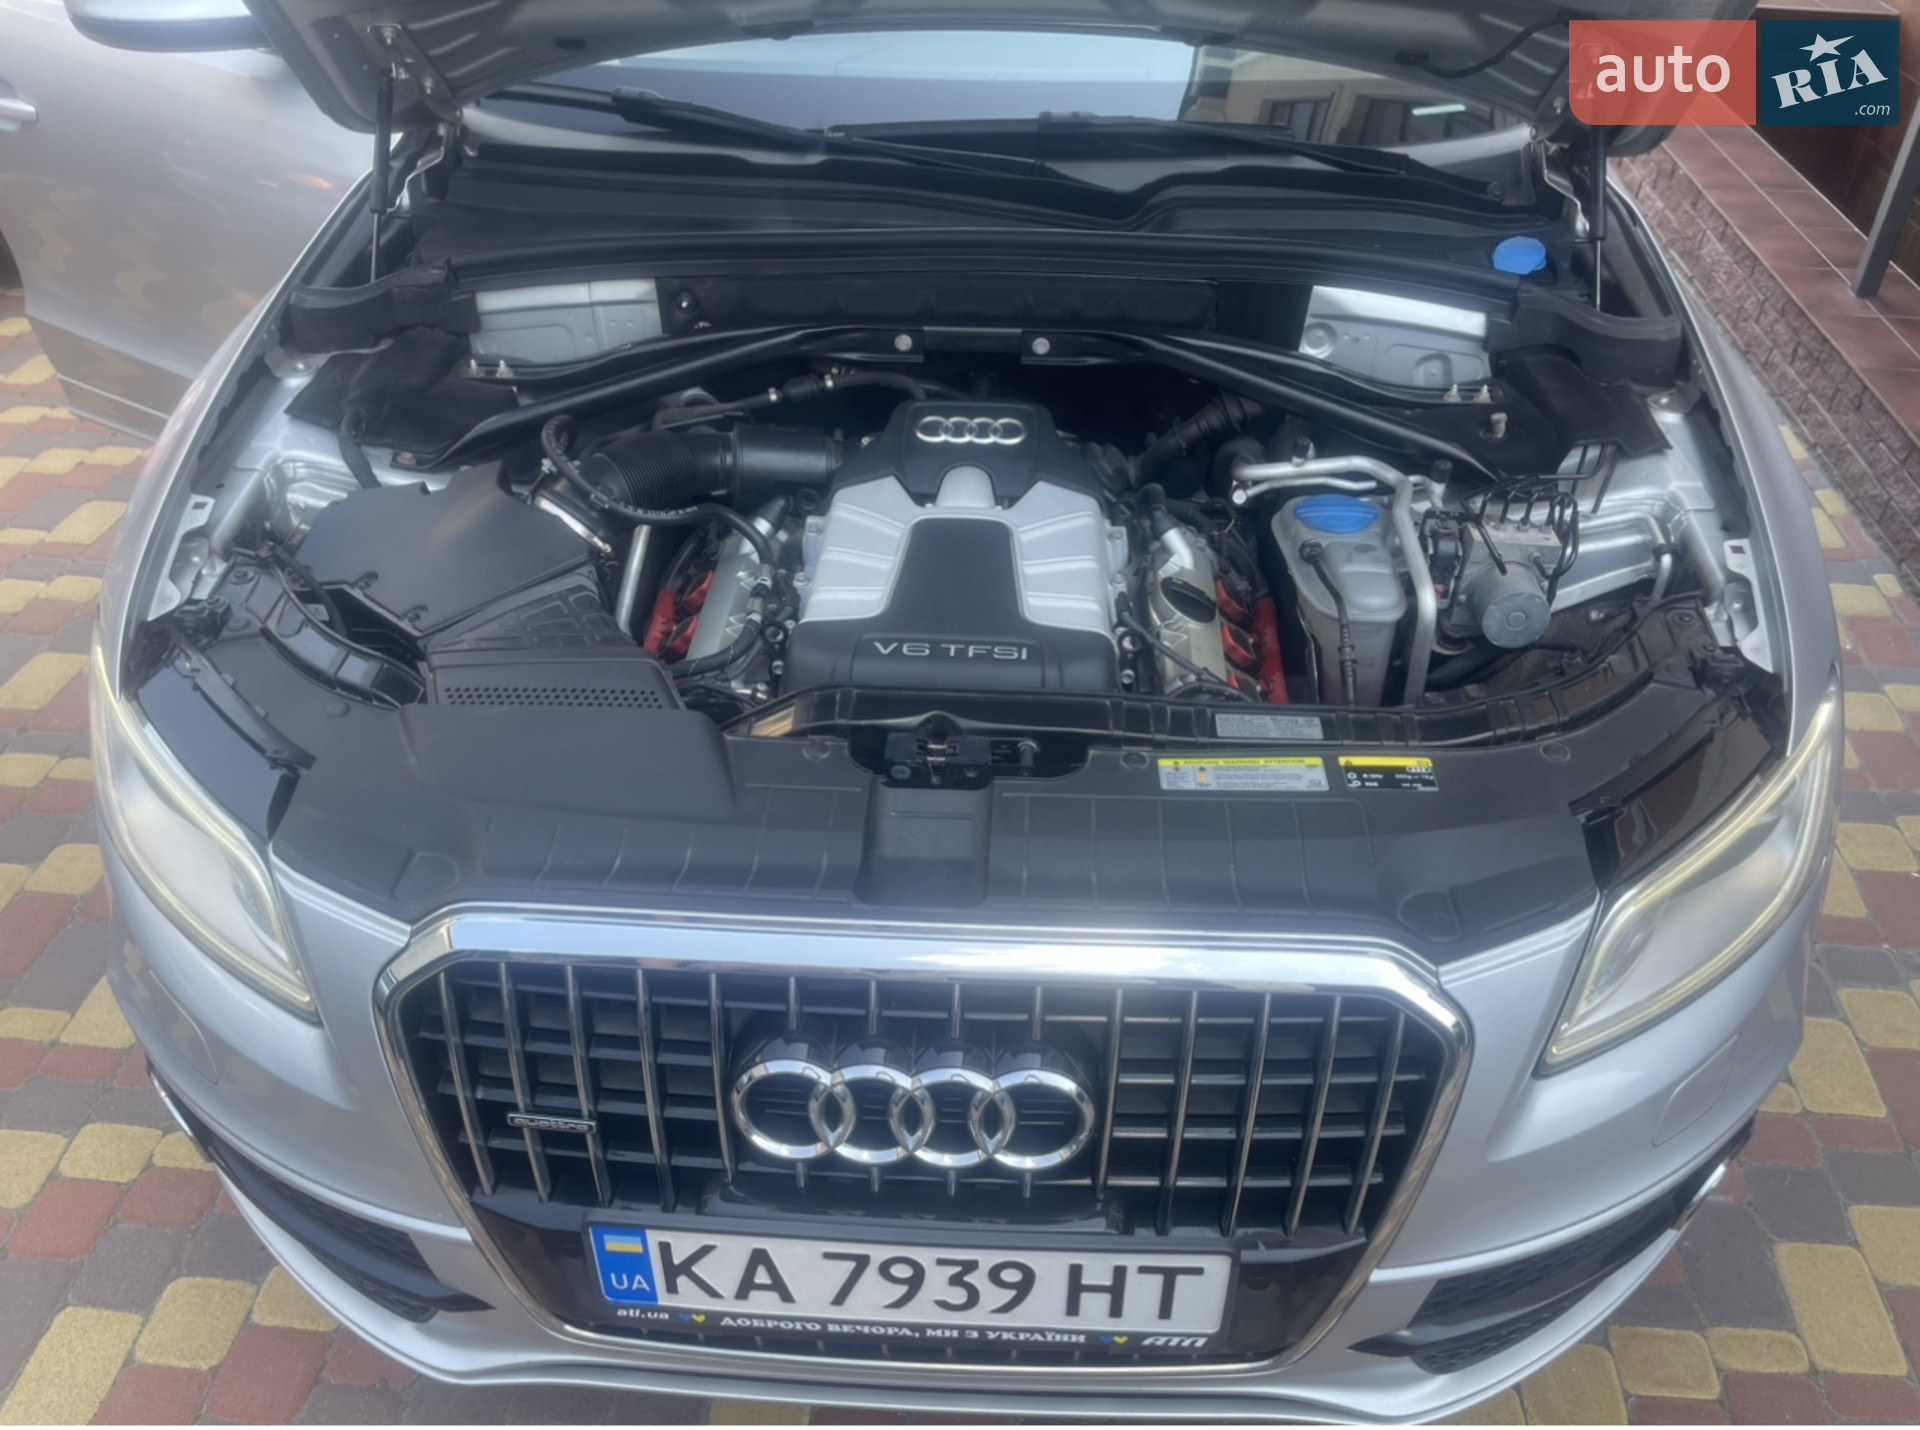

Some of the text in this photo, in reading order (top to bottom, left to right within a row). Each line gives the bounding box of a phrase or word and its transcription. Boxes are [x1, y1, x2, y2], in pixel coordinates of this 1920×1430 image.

[874, 641, 1028, 660] V6 TFSI
[514, 1118, 588, 1130] quattro
[610, 1271, 650, 1292] UA
[821, 1250, 1037, 1314] 7939
[720, 1316, 822, 1331] ДОБРОГО
[827, 1323, 920, 1338] ВЕЧОРА,
[925, 1328, 960, 1339] МИ
[985, 1330, 1086, 1344] УКРАЇНИ
